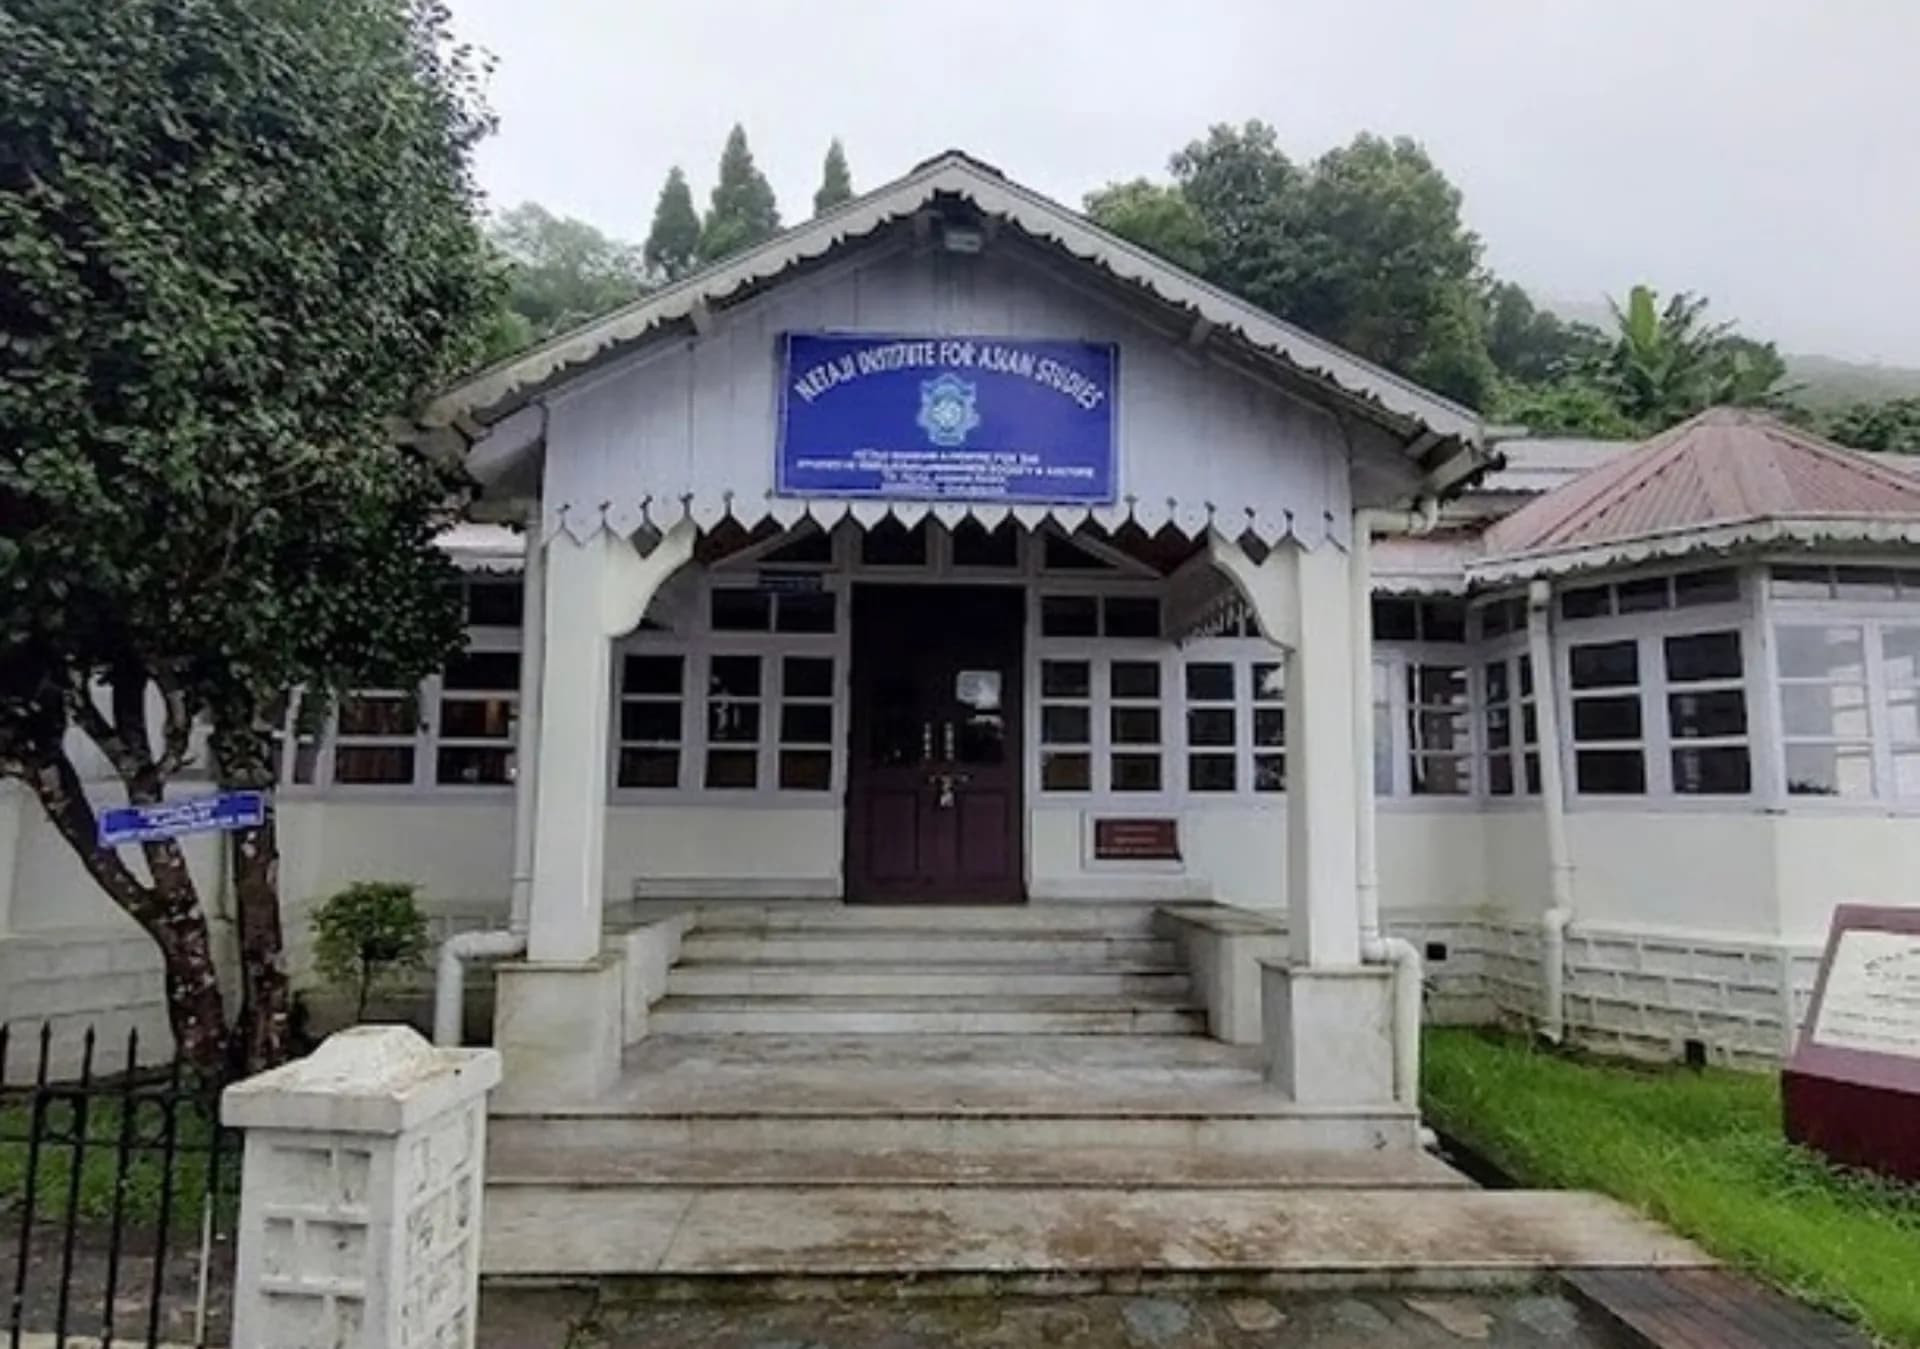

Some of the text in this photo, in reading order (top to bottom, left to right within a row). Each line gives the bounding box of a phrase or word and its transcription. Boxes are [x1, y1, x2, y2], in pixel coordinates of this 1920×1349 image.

[794, 341, 1103, 409] NETAJI INSTITUTE FOR ASIAN STUDIES
